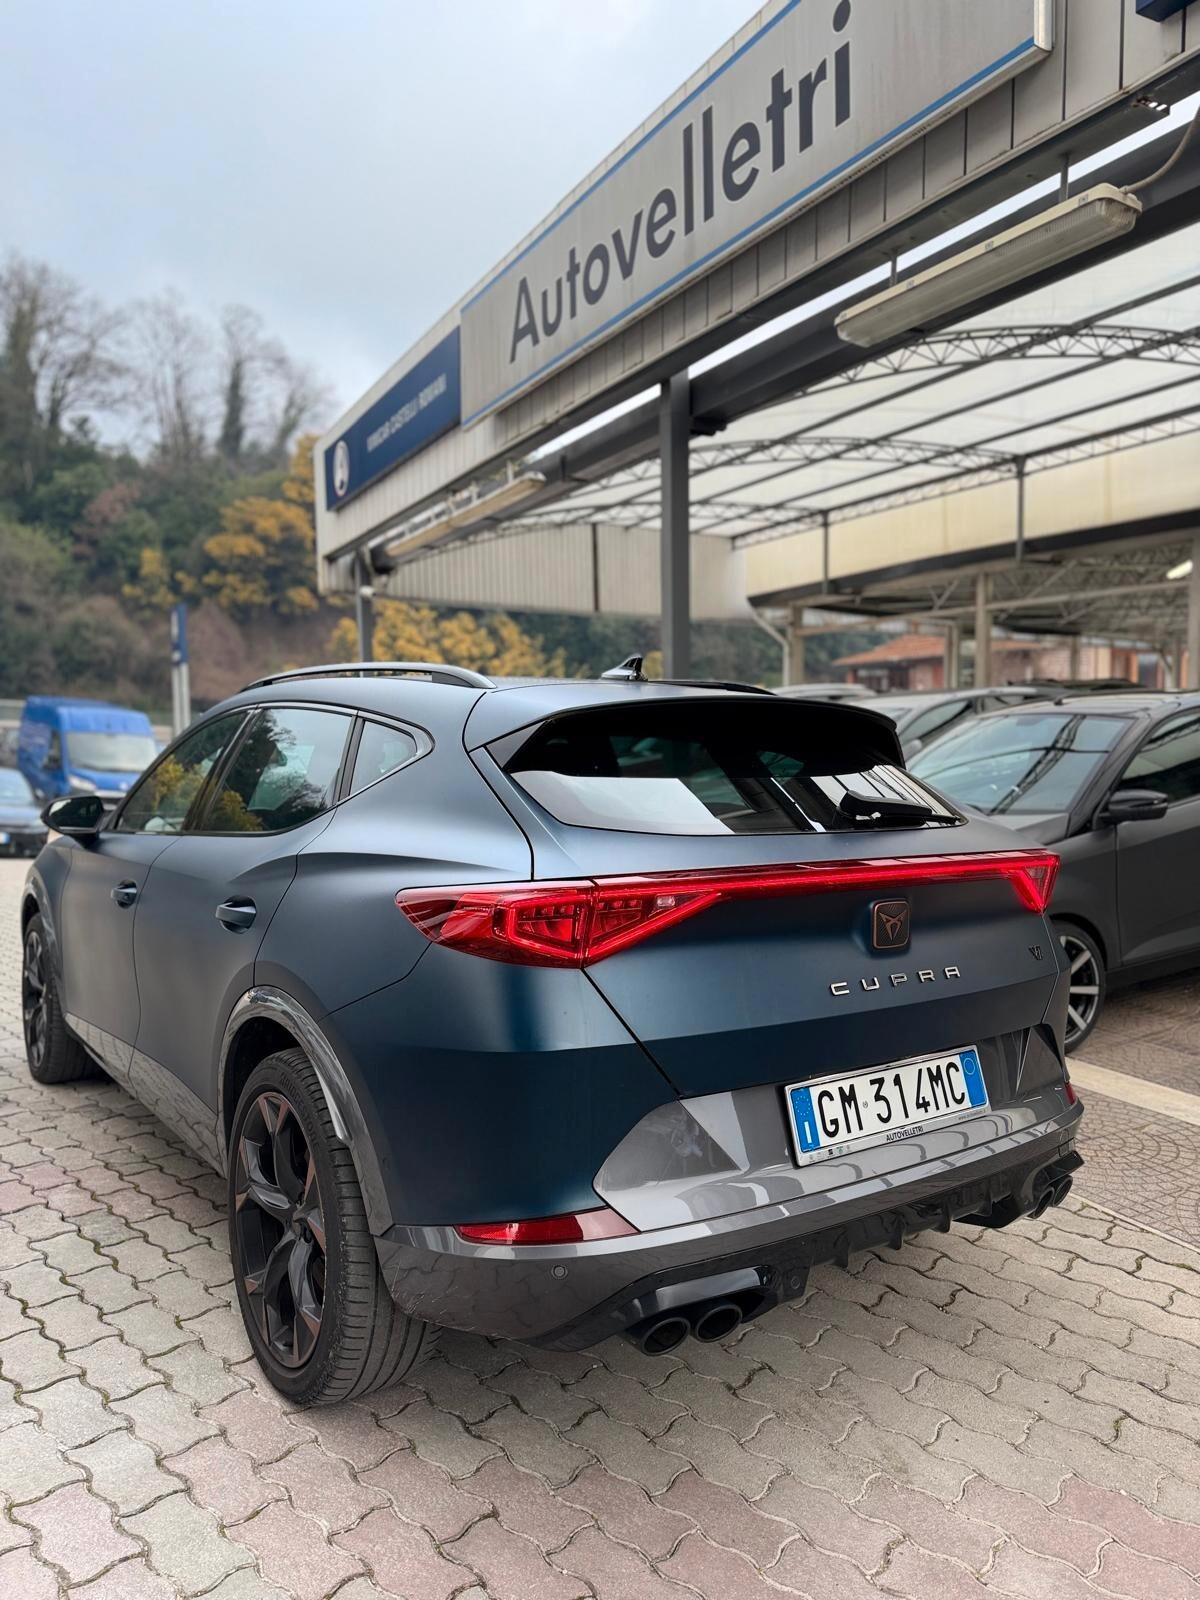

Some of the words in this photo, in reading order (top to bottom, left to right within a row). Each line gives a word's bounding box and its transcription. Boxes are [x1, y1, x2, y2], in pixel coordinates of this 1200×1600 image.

[509, 0, 851, 364] Autovelletri
[830, 966, 961, 997] CUPRA
[817, 1083, 864, 1138] GM
[870, 1061, 966, 1124] 314MC
[886, 1125, 924, 1142] AUTOVELLETRI
